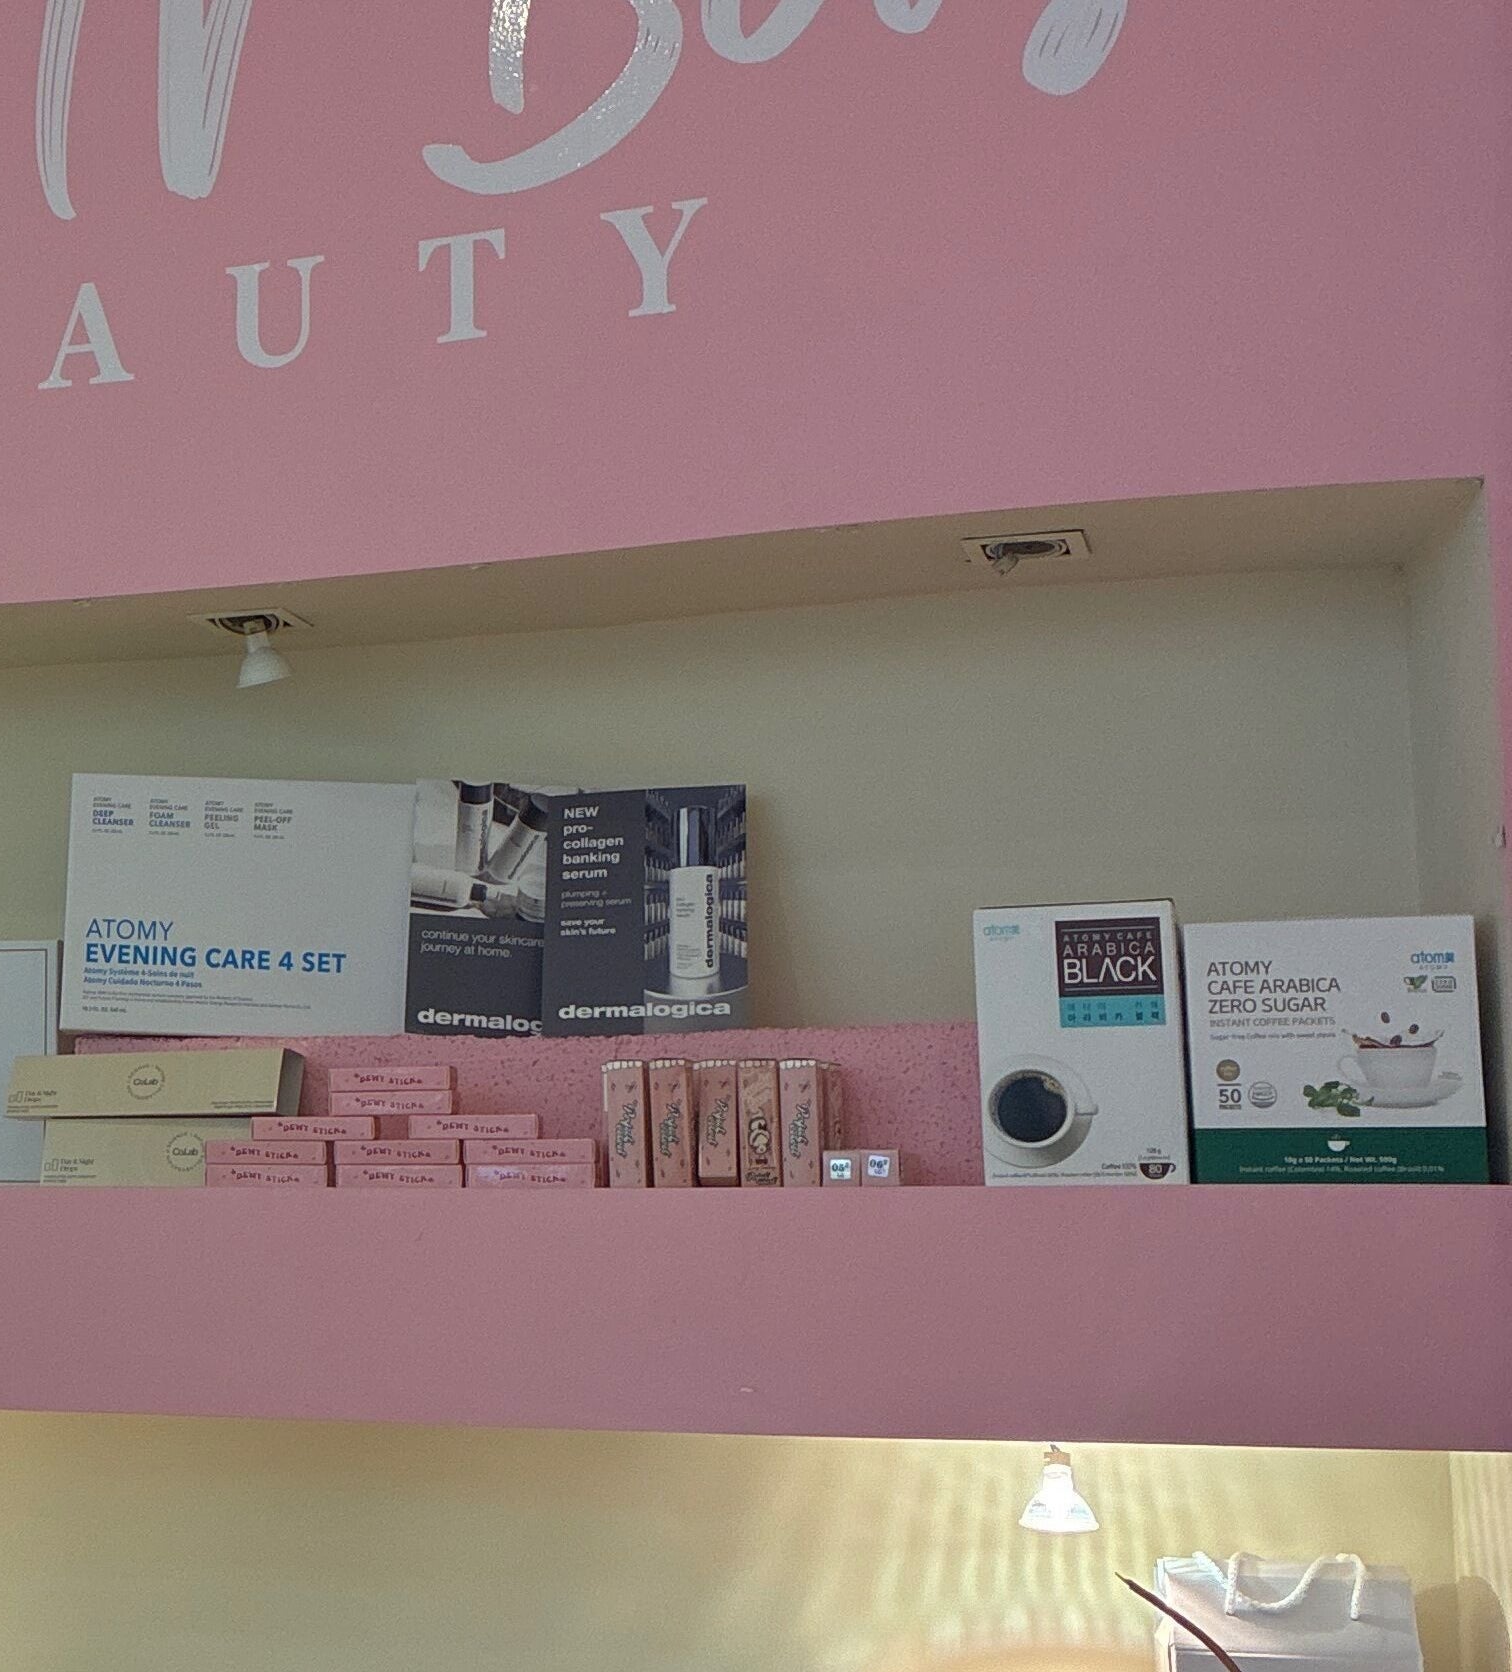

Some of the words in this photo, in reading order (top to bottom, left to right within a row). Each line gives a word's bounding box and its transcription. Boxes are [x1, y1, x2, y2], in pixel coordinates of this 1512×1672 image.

[92, 809, 114, 817] DEEP
[149, 811, 174, 820] FOAM
[204, 814, 239, 822] PEELING
[563, 806, 600, 820] NEW
[92, 818, 134, 826] CLEANSER
[149, 820, 191, 828] CLEANSER
[254, 815, 293, 824] PEEL-OFF
[204, 822, 220, 830] GEL
[253, 823, 278, 831] MASK
[563, 824, 594, 836] pro-
[563, 837, 624, 850] collagen
[562, 852, 620, 865] banking
[562, 868, 608, 880] serum
[560, 919, 582, 927] save
[583, 919, 606, 927] your
[704, 874, 714, 969] dermalogica
[85, 918, 174, 941] ATOMY
[560, 927, 587, 936] skin's
[588, 927, 616, 936] future
[421, 929, 469, 942] continue
[471, 933, 496, 945] your
[1063, 932, 1111, 942] ATOMY
[1117, 931, 1153, 941] CAFE
[419, 940, 461, 956] journey
[463, 944, 475, 955] at
[477, 945, 513, 958] home.
[1063, 941, 1156, 957] ARABICA
[85, 943, 197, 967] EVENING
[205, 947, 271, 971] CARE
[278, 951, 294, 972] 4
[301, 951, 347, 974] SET
[1063, 955, 1158, 984] BLACK
[1206, 960, 1273, 977] ATOMY
[1207, 979, 1255, 995] CAFE
[1259, 977, 1341, 994] ARABICA
[558, 1002, 732, 1020] dermalogica
[1208, 998, 1257, 1014] ZERO
[1261, 996, 1327, 1013] SUGAR
[1209, 1018, 1251, 1028] INSTANT
[1253, 1017, 1289, 1027] COFFEE
[1292, 1016, 1337, 1026] PACKETS
[1218, 1088, 1242, 1104] 50
[1148, 1164, 1163, 1174] 80
